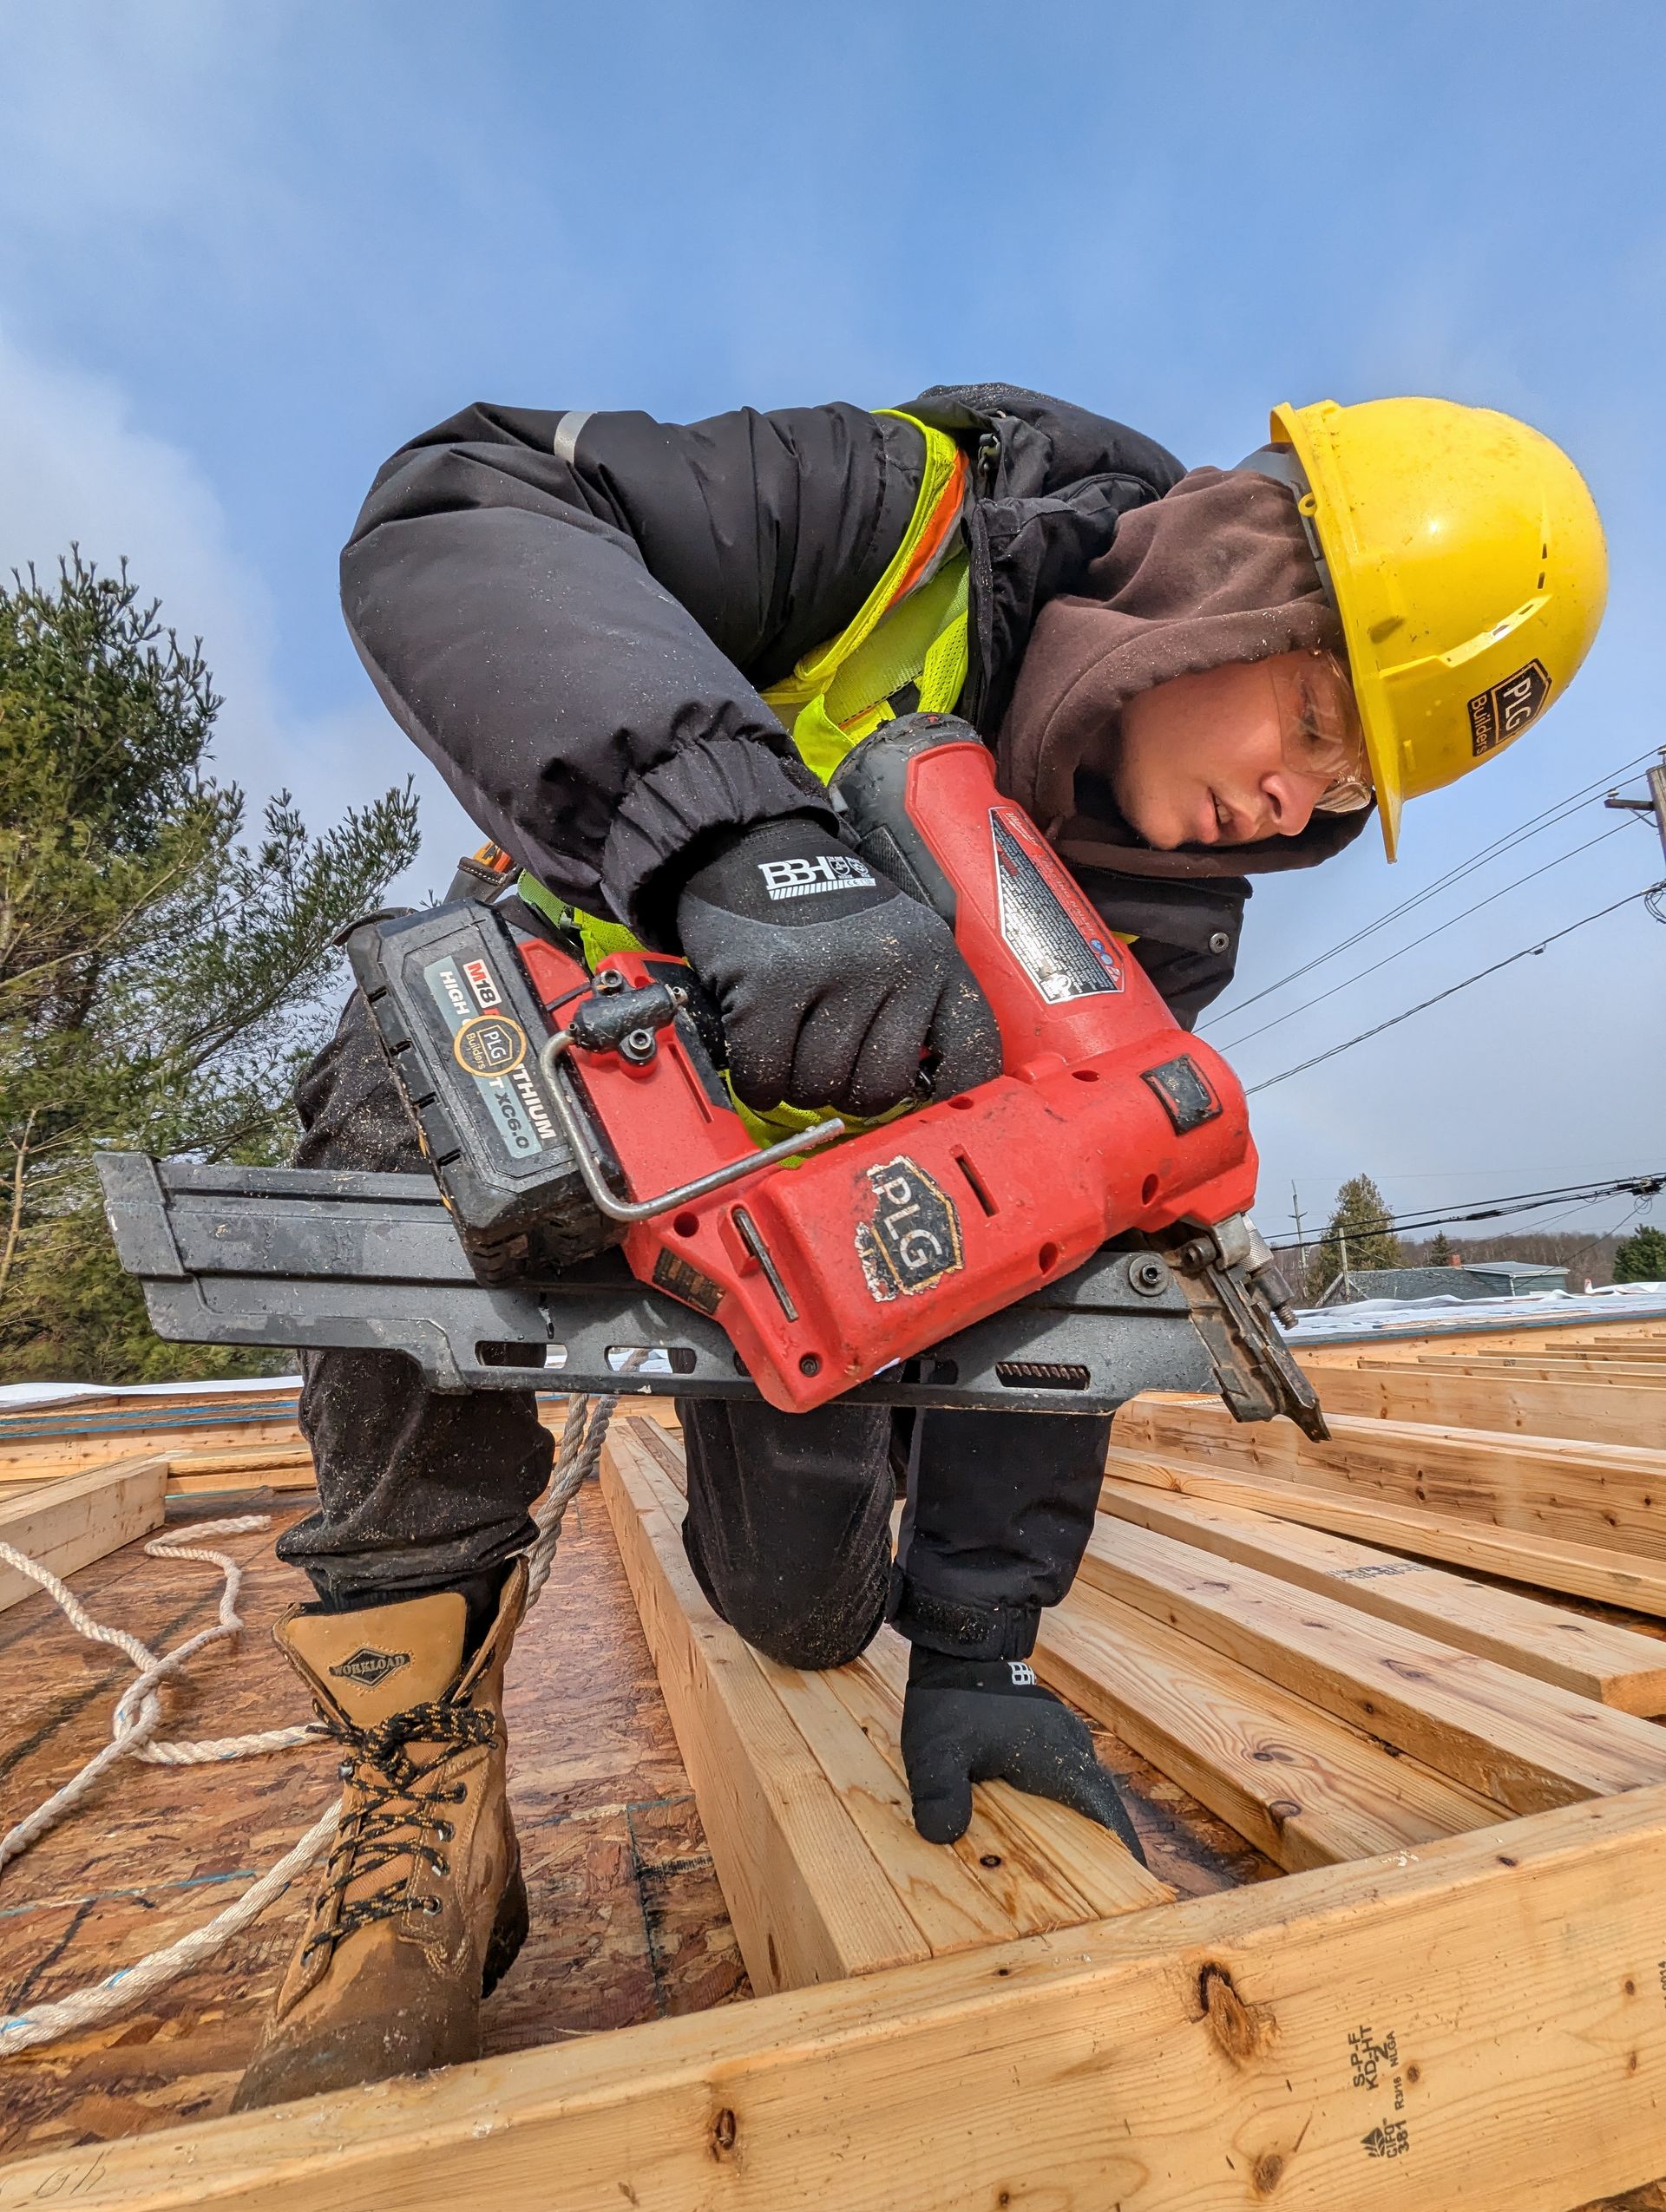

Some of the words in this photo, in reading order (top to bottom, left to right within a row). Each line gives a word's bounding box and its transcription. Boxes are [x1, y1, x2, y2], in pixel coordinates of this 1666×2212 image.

[1471, 694, 1492, 755] Builders
[1503, 677, 1532, 730] PLG
[758, 856, 836, 890] BBH
[439, 971, 470, 1015] HIGH
[467, 964, 495, 1004] M18
[465, 1032, 487, 1070] Builders
[482, 1030, 507, 1060] PLG
[494, 1092, 529, 1149] XC6.0
[872, 1176, 943, 1268] PLG
[1348, 2032, 1366, 2087] S-P-F
[1360, 2025, 1379, 2091] KD-HT
[1374, 2043, 1388, 2062] 2
[1387, 2030, 1400, 2068] NLGA
[1395, 2119, 1410, 2155] 381
